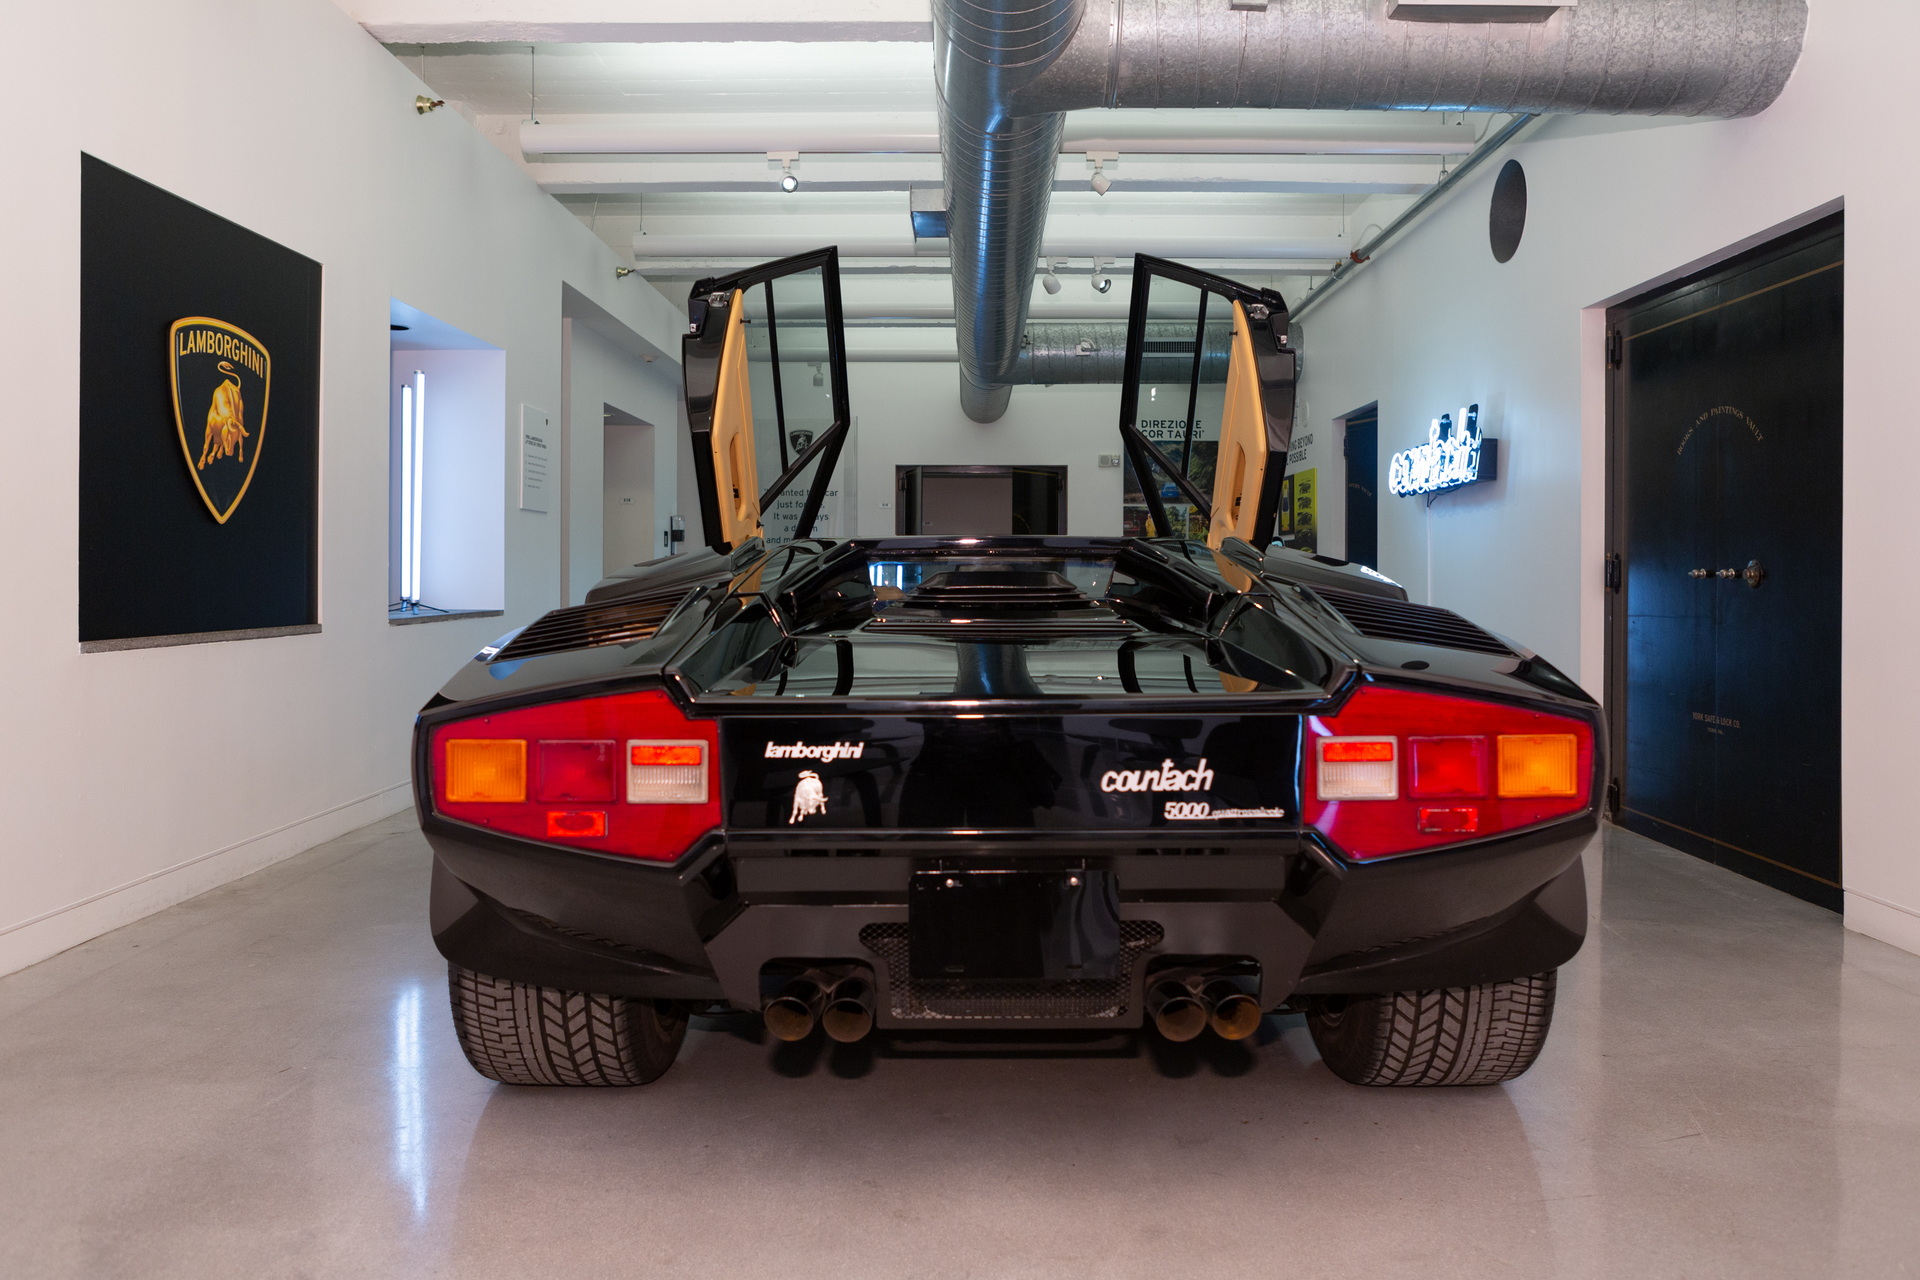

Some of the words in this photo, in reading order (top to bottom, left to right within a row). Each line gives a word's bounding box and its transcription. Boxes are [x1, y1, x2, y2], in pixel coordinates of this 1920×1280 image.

[179, 329, 264, 379] LAMBORGHINI
[1141, 420, 1202, 429] DIREZIOE
[1695, 411, 1709, 428] AND
[1710, 405, 1744, 420] PAINTINGS
[1746, 416, 1764, 442] VAULT
[1297, 433, 1314, 449] BEYOND
[1289, 448, 1307, 465] POSSIBLE
[776, 501, 793, 510] just
[773, 512, 780, 520] It
[766, 536, 781, 544] and
[1692, 712, 1703, 720] YORK
[1704, 714, 1716, 724] SAFE
[1720, 717, 1732, 727] LOCK
[764, 741, 865, 763] lamborghini
[1100, 757, 1215, 792] countach
[1163, 801, 1210, 819] 5000
